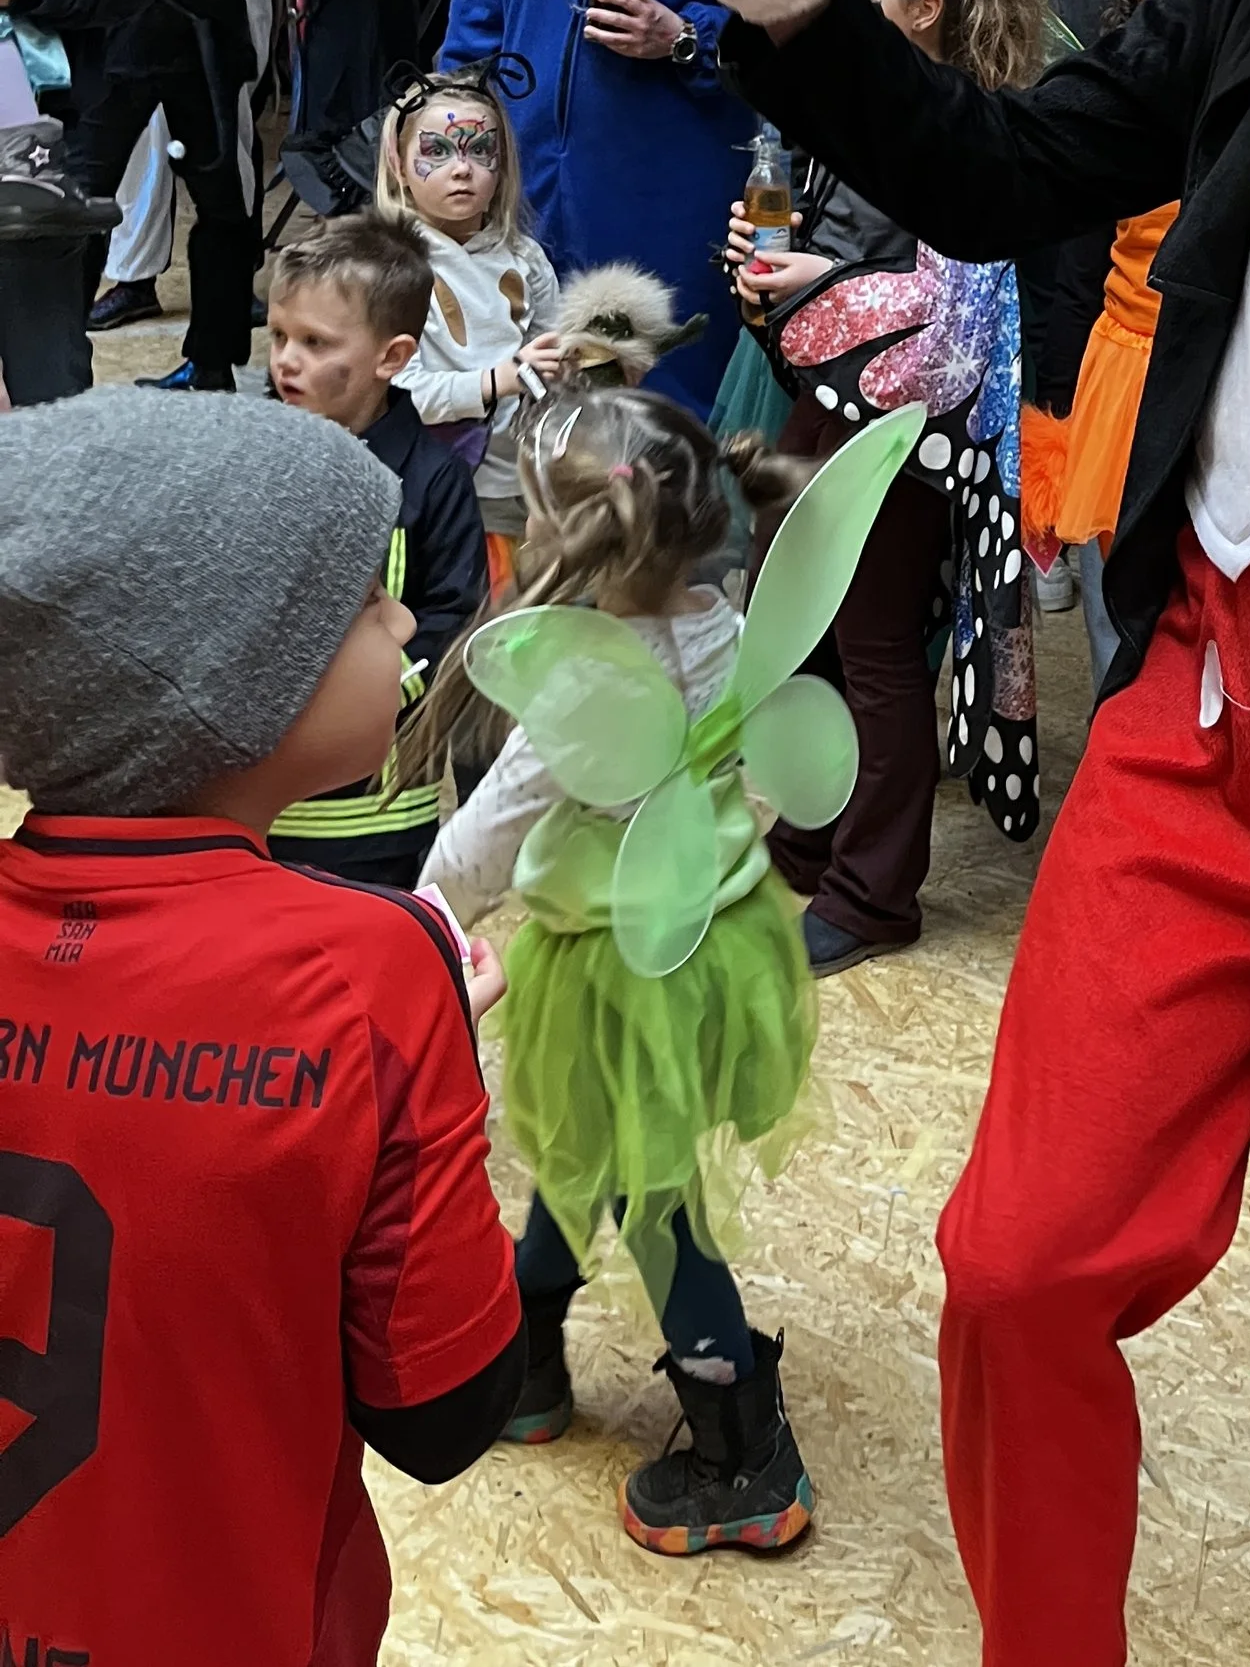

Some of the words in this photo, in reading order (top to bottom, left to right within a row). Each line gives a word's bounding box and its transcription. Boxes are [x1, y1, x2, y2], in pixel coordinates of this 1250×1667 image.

[56, 922, 98, 940] SAN
[44, 942, 83, 962] MIA
[66, 1031, 331, 1109] MÜNCHEN
